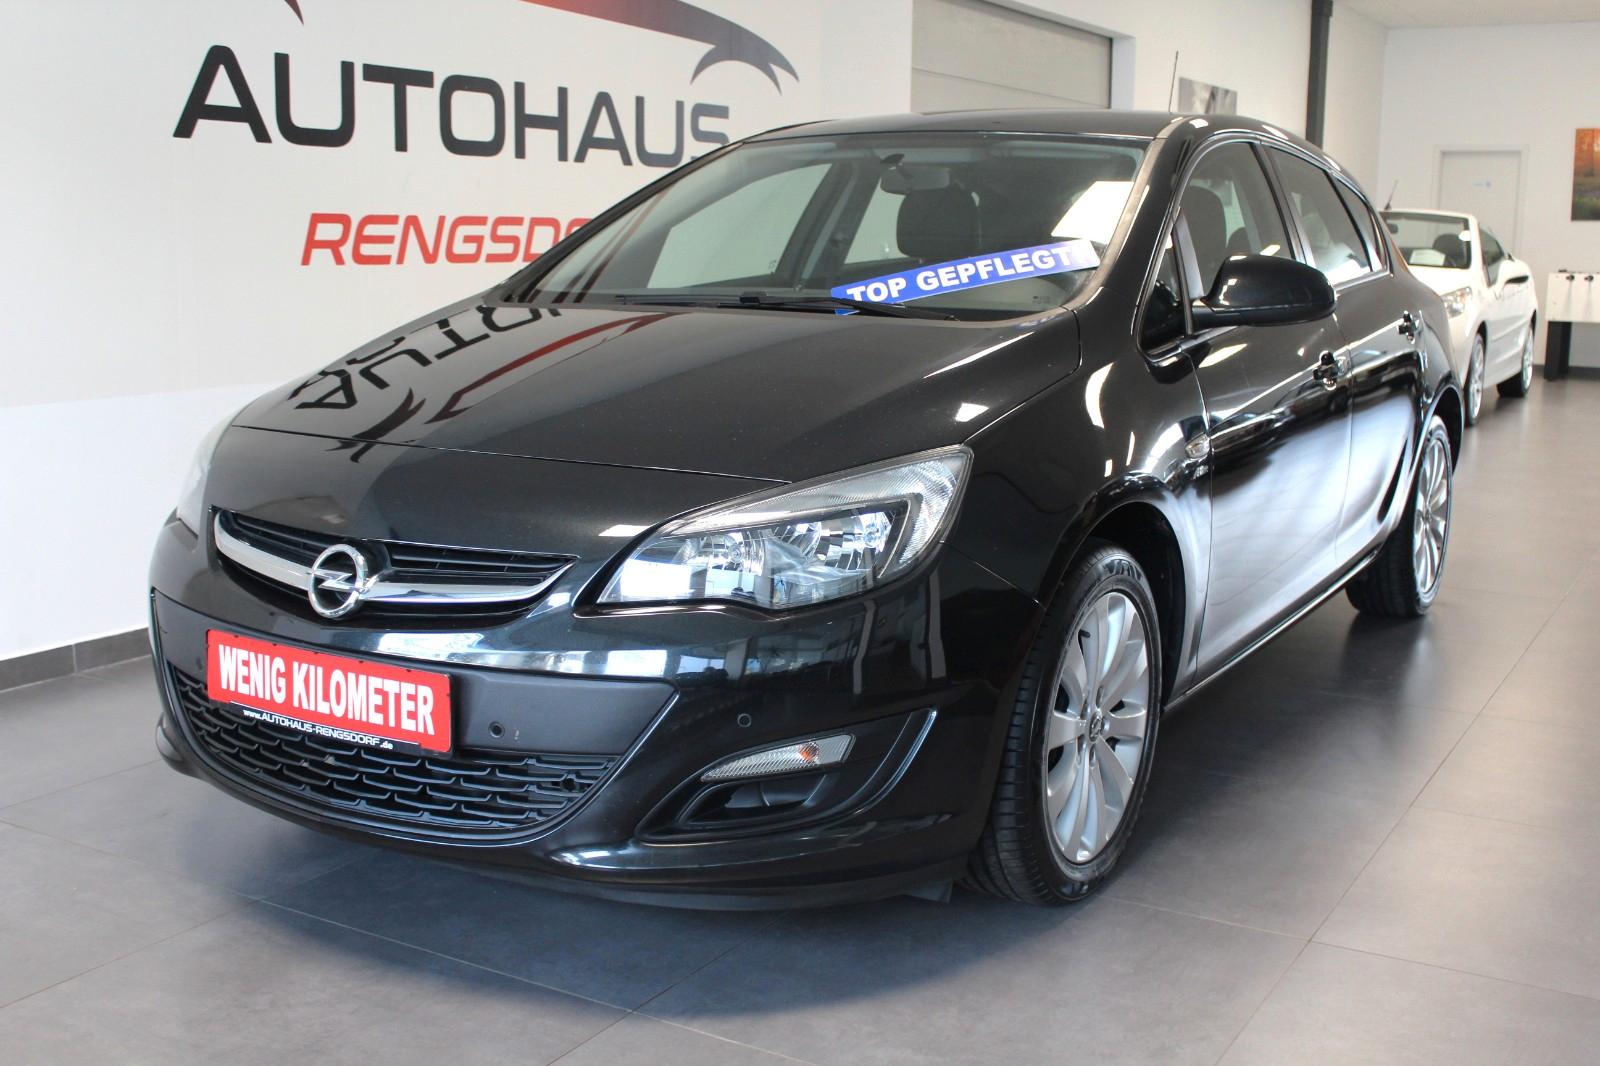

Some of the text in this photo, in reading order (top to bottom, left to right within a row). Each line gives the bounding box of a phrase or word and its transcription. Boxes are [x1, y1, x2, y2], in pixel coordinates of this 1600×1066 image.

[173, 45, 729, 168] AUTOHAUS
[847, 277, 906, 302] TOP
[219, 645, 435, 735] WENIG KILOMETER
